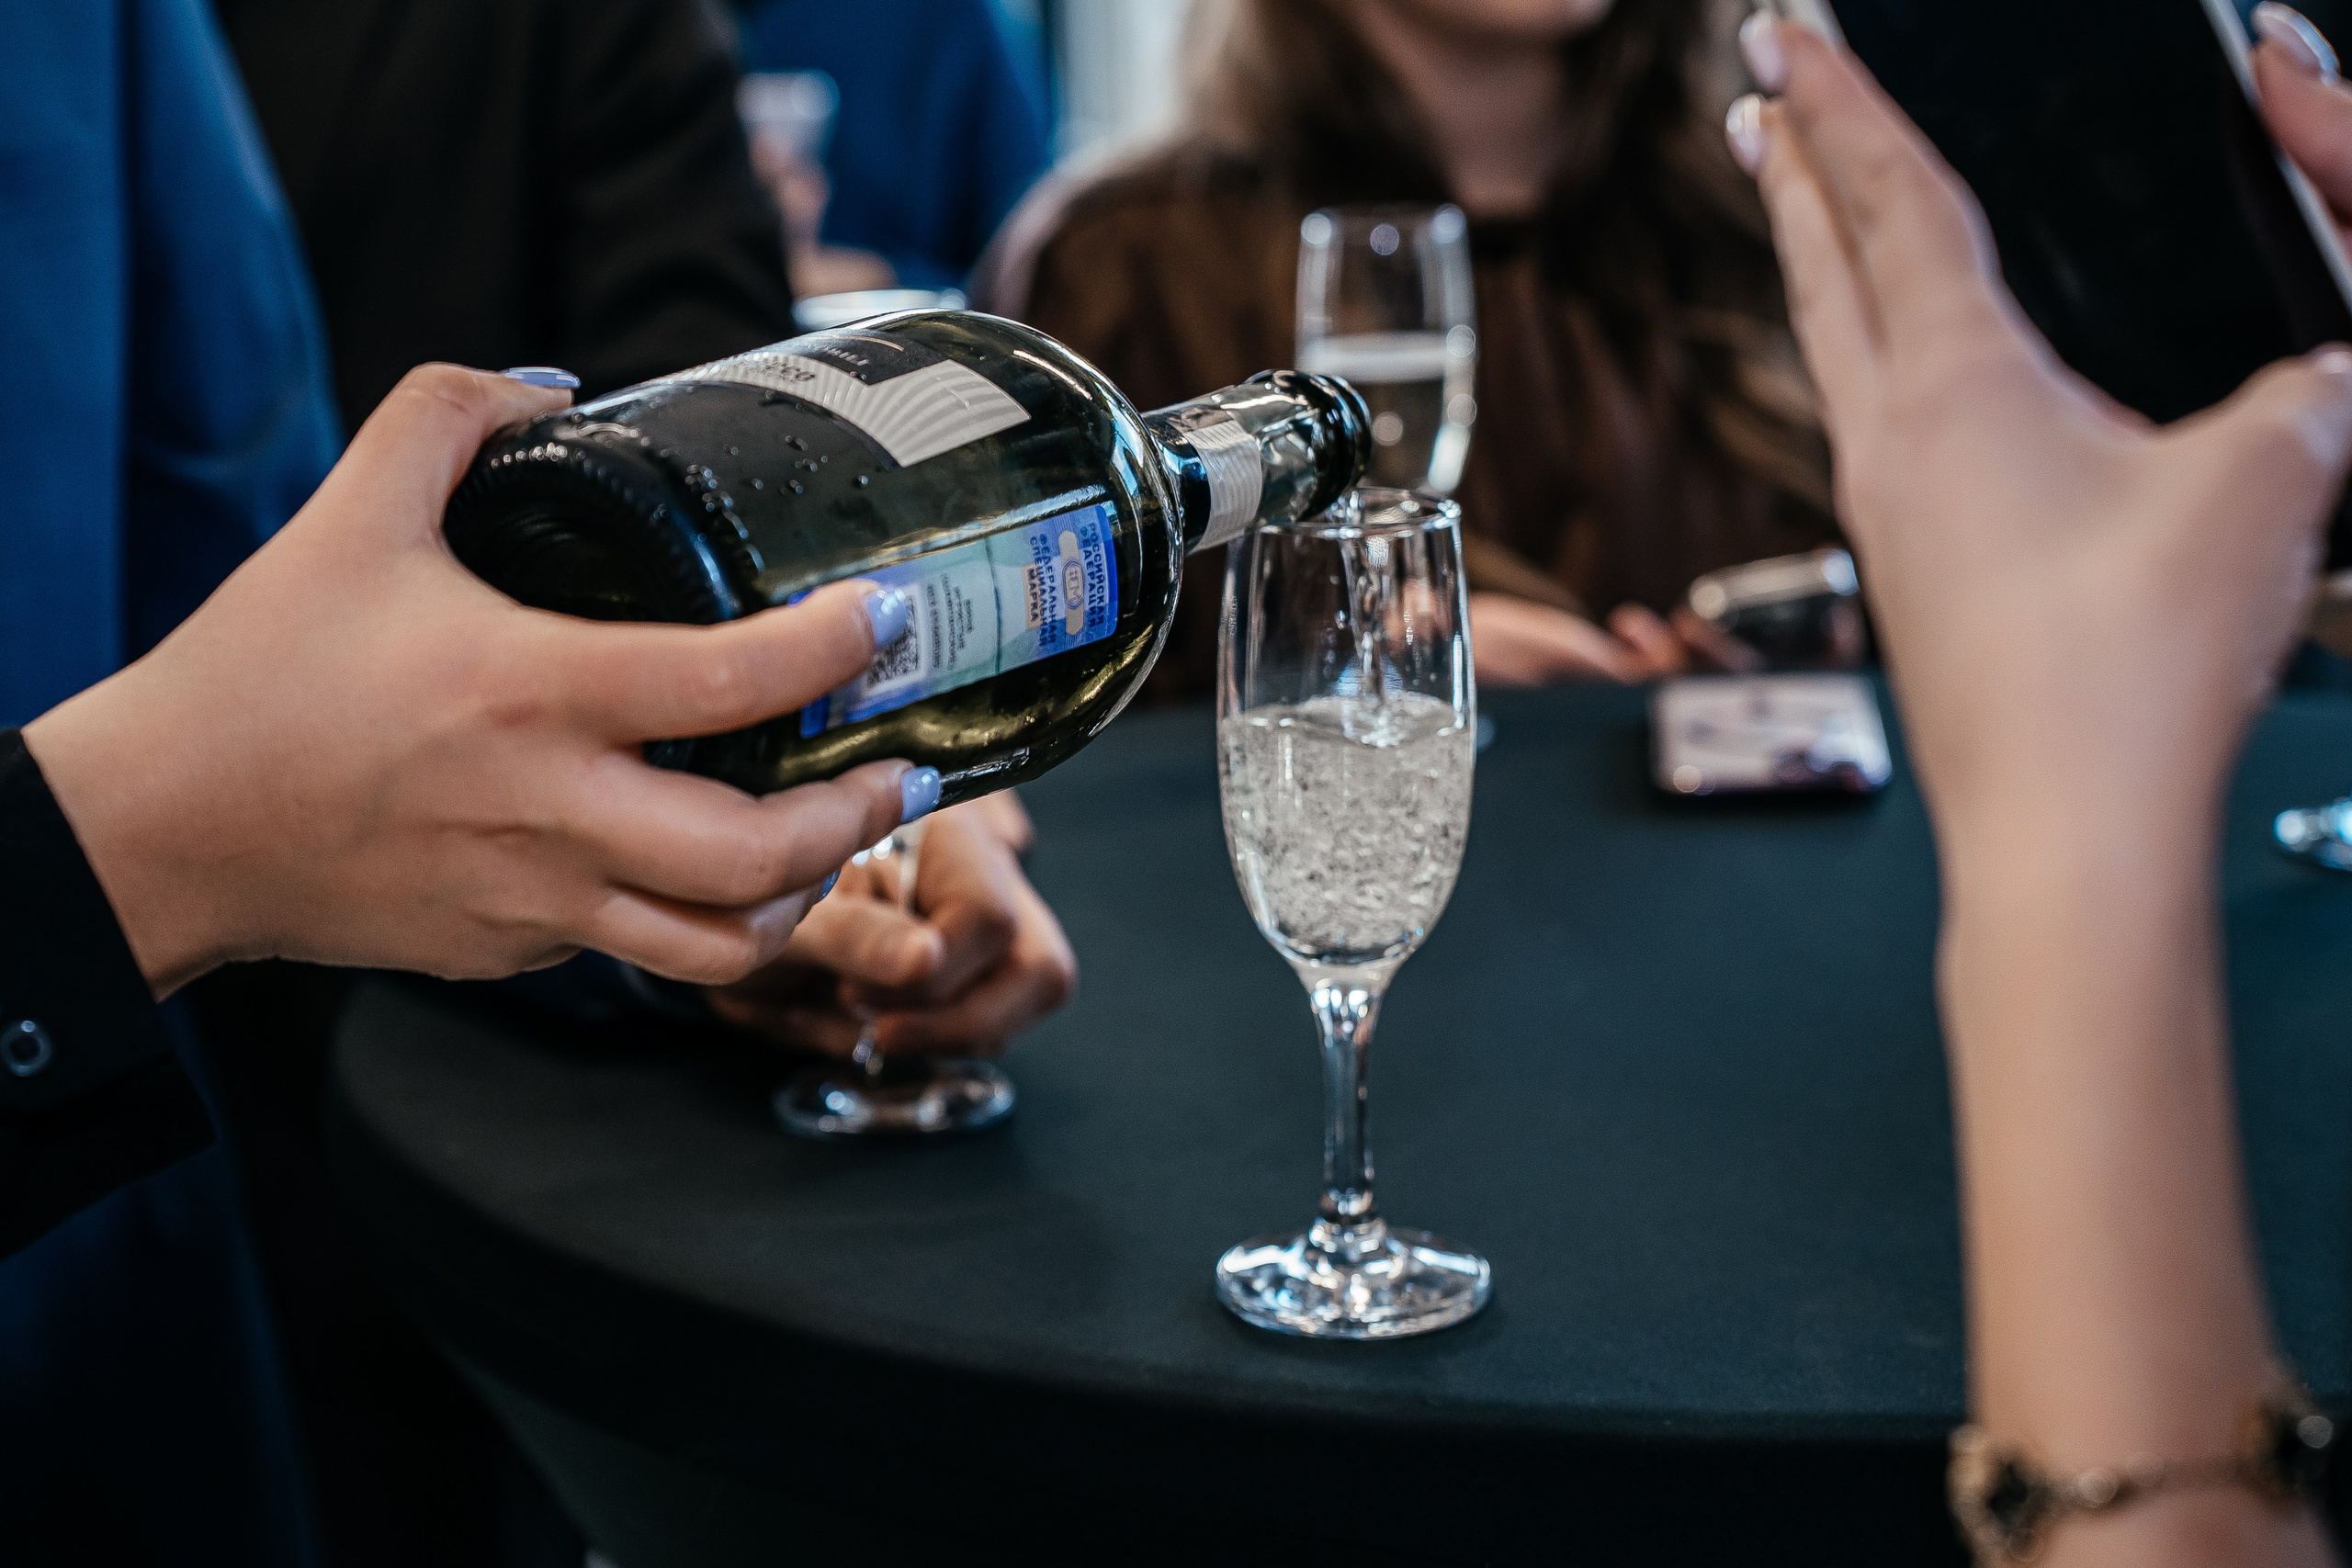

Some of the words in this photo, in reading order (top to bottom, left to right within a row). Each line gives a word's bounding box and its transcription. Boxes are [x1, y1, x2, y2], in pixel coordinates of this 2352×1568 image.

[1026, 569, 1039, 622] МАРКА
[1029, 536, 1047, 647] СПЕЦИАЛЬНАЯ
[1039, 534, 1057, 644] ФЕДЕРАЛЬНАЯ
[1080, 525, 1097, 627] ФЕДЕРАЦИЯ
[1088, 522, 1105, 625] РОССИЙСКАЯ
